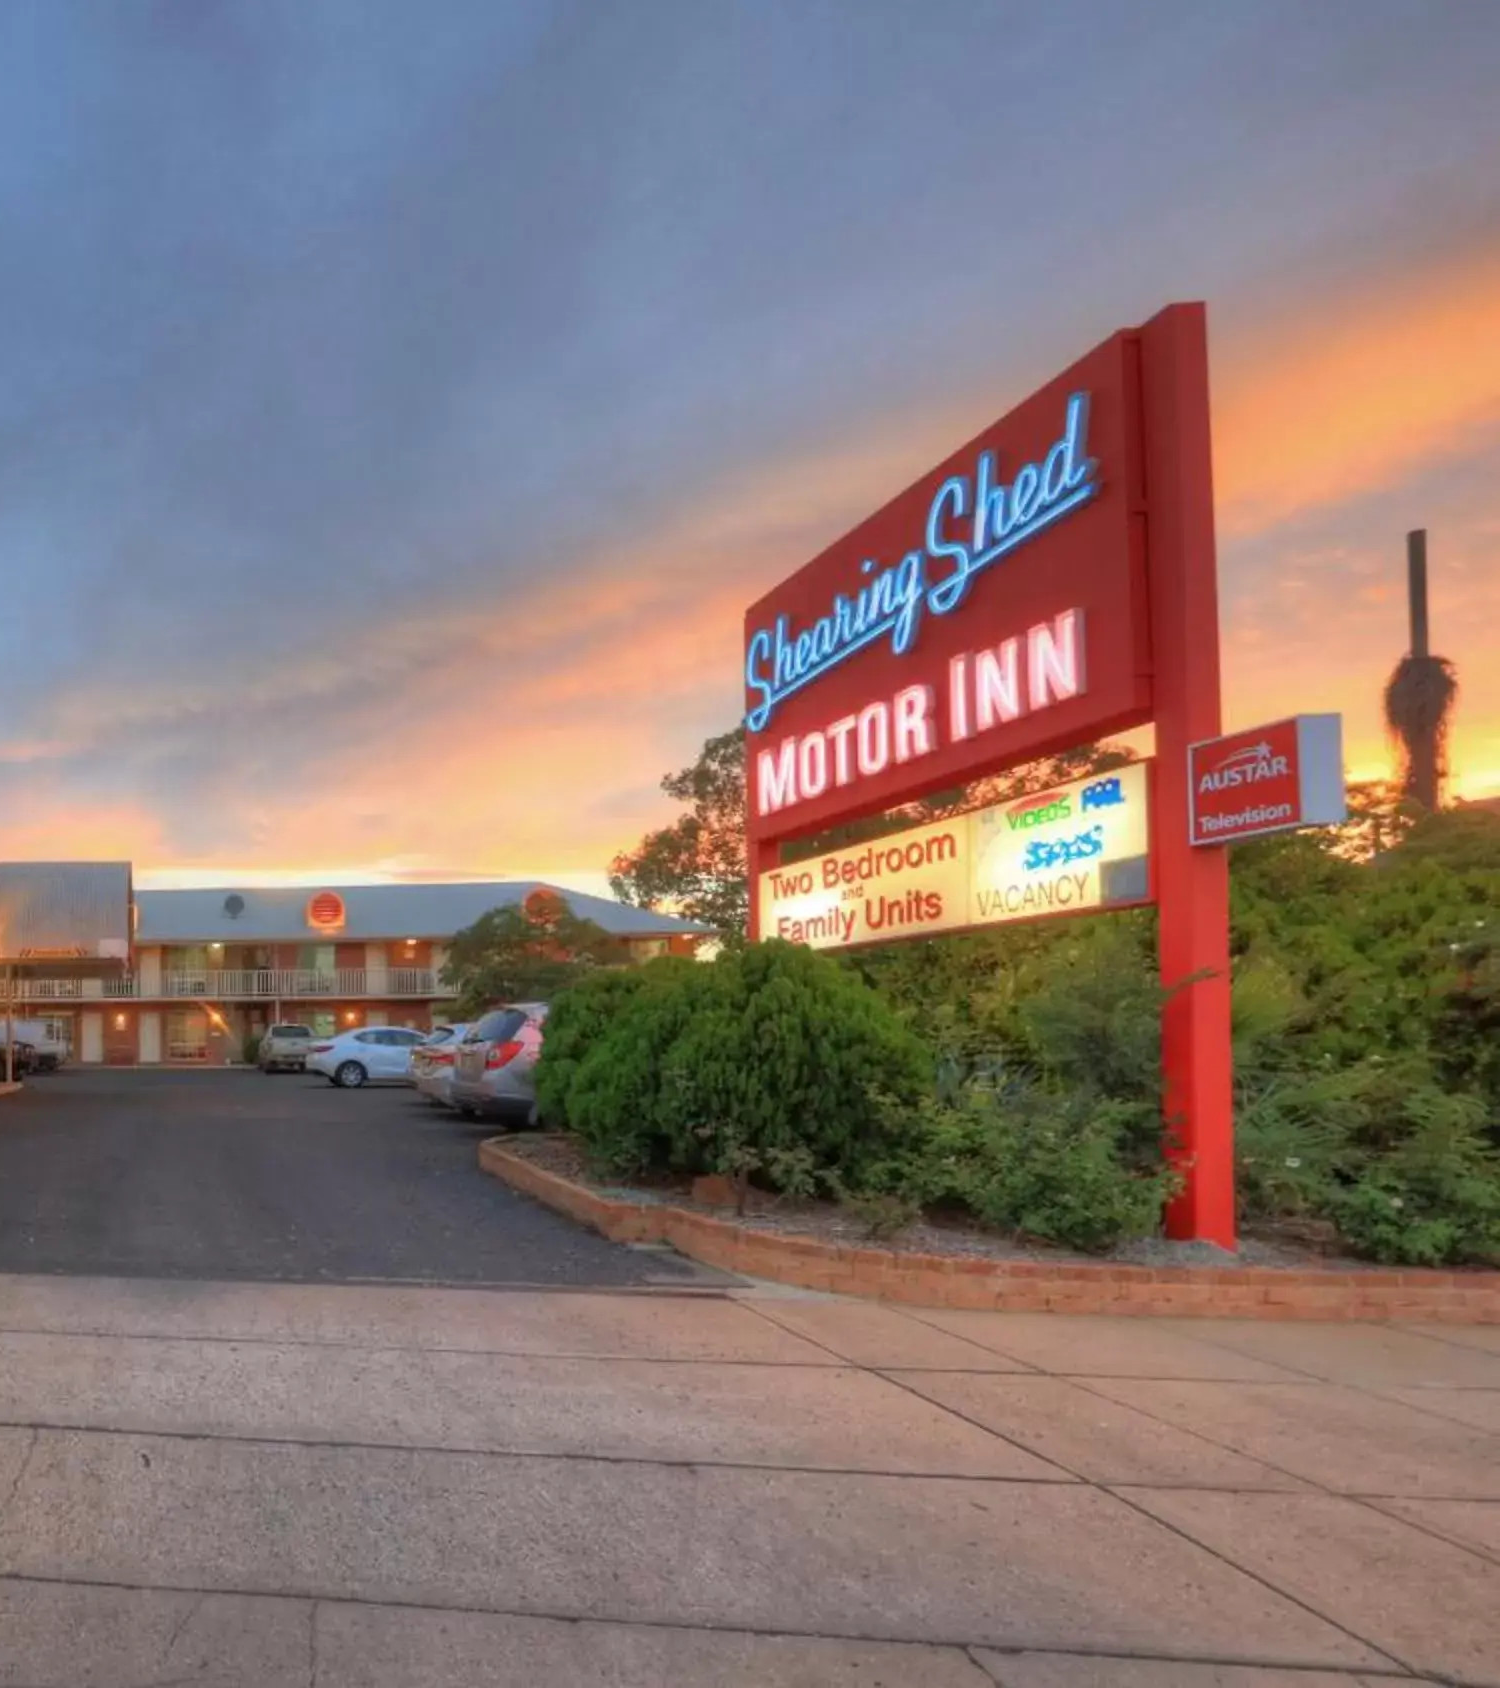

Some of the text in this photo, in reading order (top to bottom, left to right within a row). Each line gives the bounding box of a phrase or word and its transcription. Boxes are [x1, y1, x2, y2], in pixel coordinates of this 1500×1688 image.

[744, 391, 1098, 733] Shearing Shed
[757, 606, 1087, 817] MOTOR INN
[1199, 755, 1288, 793] AUSTAR
[1005, 794, 1072, 830] VIDEOS
[1198, 803, 1293, 833] Television
[768, 833, 957, 900] Two Bedroom
[840, 883, 864, 901] and
[977, 871, 1090, 917] VACANCY
[778, 889, 943, 945] Family Units
